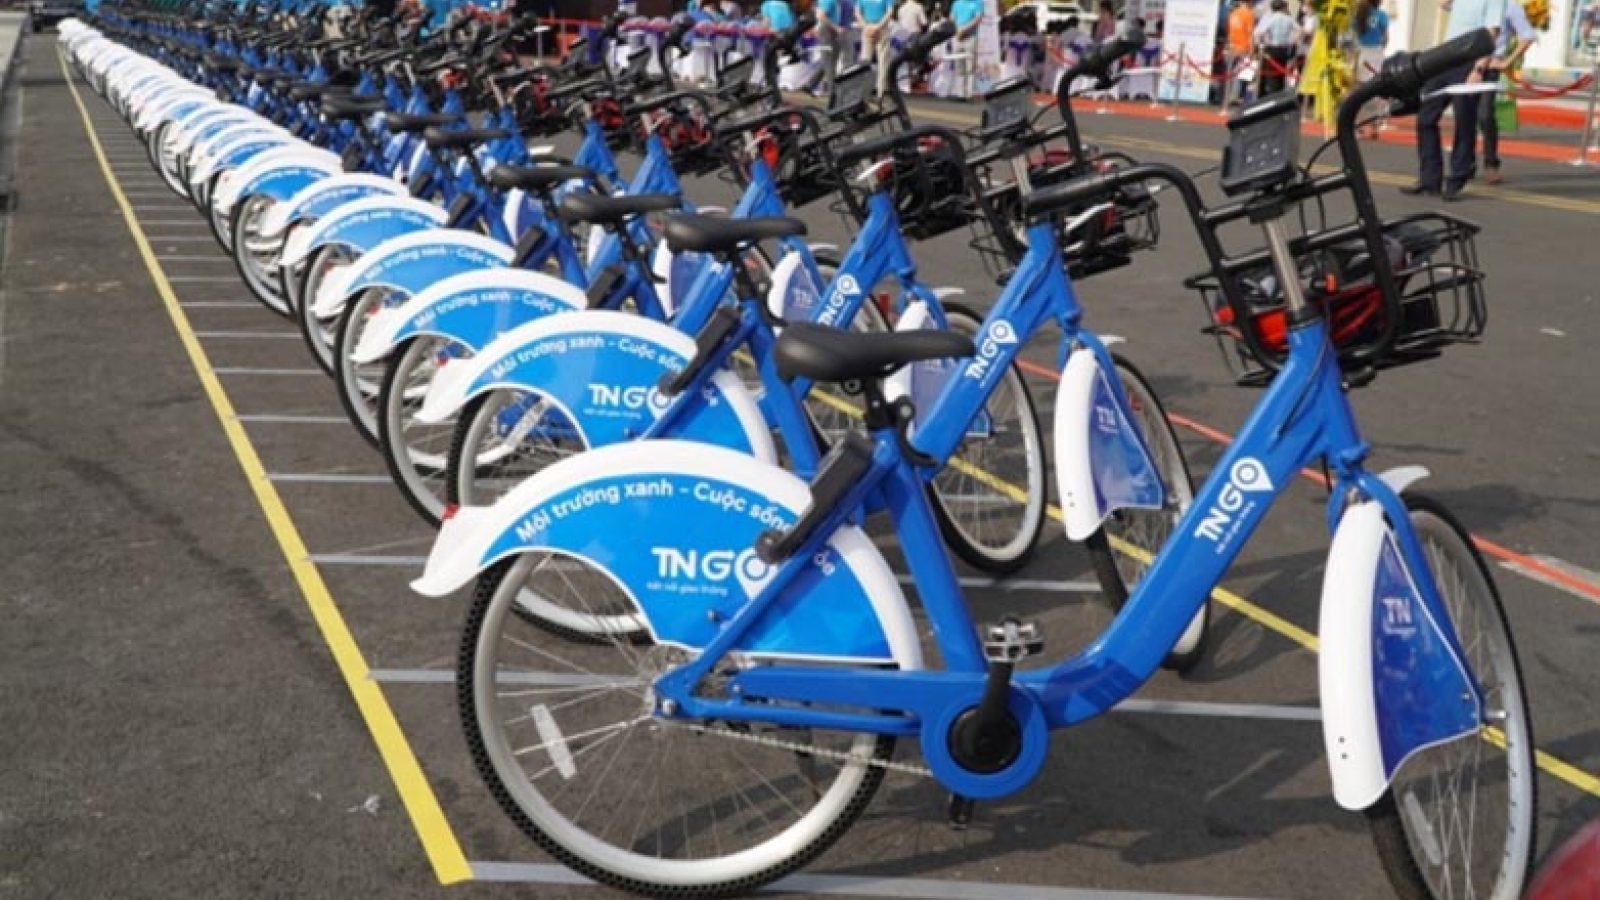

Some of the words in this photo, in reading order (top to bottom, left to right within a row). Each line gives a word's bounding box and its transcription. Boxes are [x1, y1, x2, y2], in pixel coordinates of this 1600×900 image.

[965, 319, 1019, 379] TNGO
[515, 508, 551, 542] Môi
[552, 484, 620, 519] trường
[624, 478, 672, 498] xanh
[693, 481, 747, 512] Cuộc
[1194, 457, 1274, 541] TNGO
